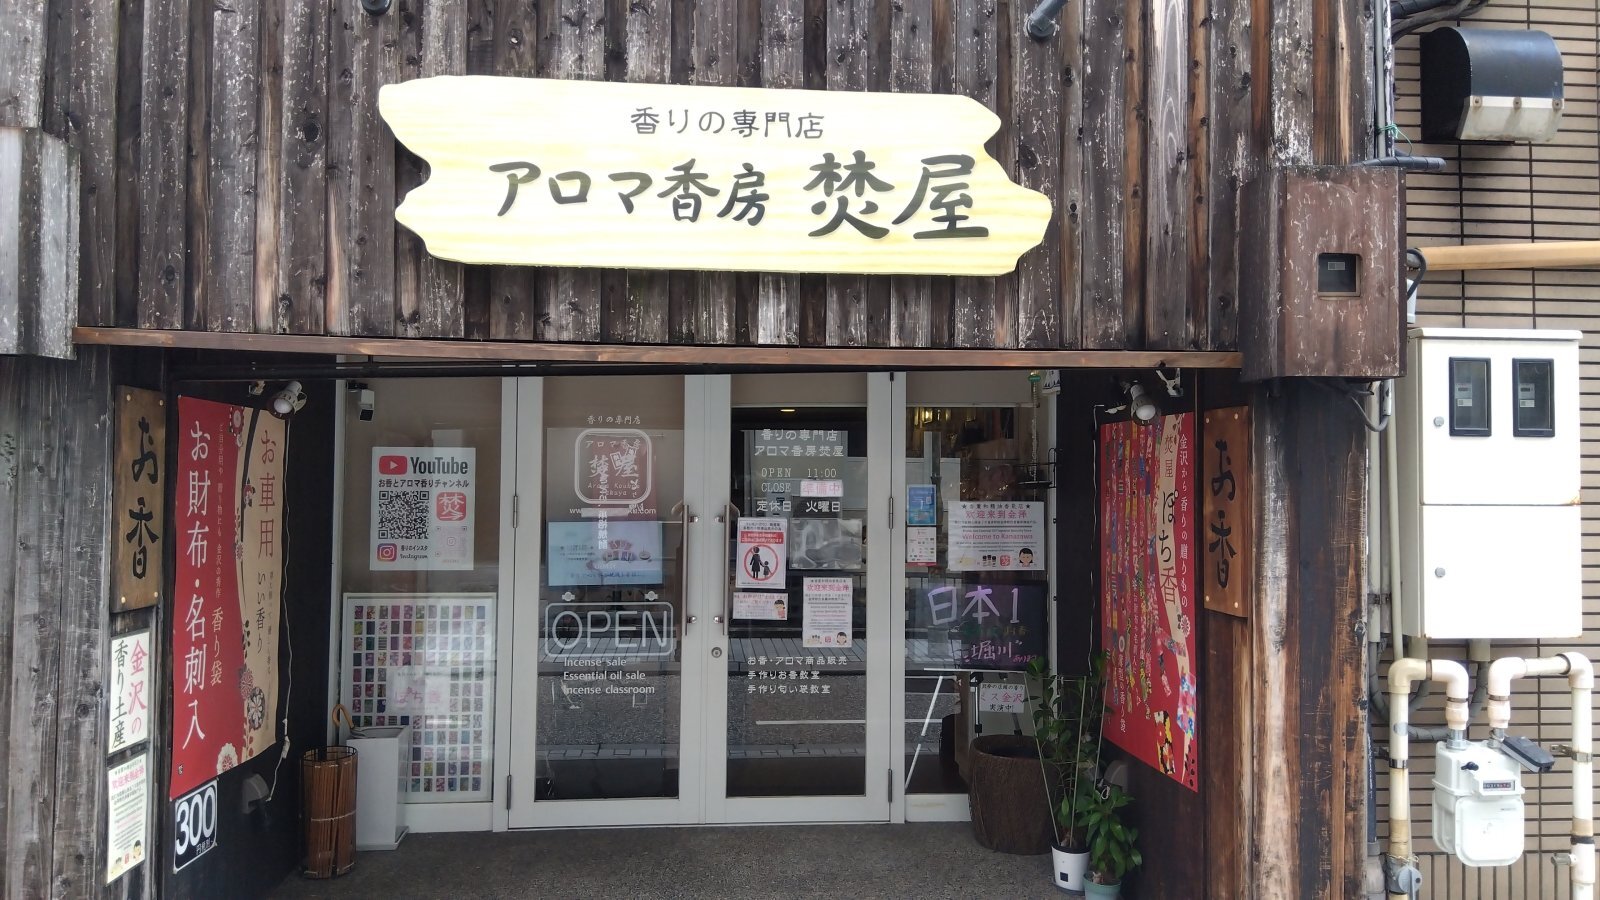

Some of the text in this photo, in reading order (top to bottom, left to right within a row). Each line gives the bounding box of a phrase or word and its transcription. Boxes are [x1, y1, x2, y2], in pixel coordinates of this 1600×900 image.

[629, 107, 826, 139] 香りの専門店
[488, 150, 990, 240] アロマ香房 焚屋
[761, 429, 838, 441] 香りの専門店
[754, 446, 844, 457] アロマ香房焚屋
[410, 456, 469, 475] YouTube
[761, 467, 837, 478] OPEN 11:00
[378, 479, 470, 489] お香とアロマ香りチャンネル
[761, 482, 792, 493] CLOSE
[258, 429, 277, 559] お車用
[756, 500, 841, 513] 定休日 火曜日
[256, 571, 266, 654] いい香り
[552, 610, 668, 650] OPEN
[564, 657, 627, 667] Incense sale
[747, 656, 848, 665] お香・アロマ商品販売
[563, 670, 646, 681] Essential oil sale
[128, 640, 149, 735] 金沢の
[605, 685, 655, 694] classroom
[111, 640, 129, 749] 香り土産
[175, 786, 216, 856] 300
